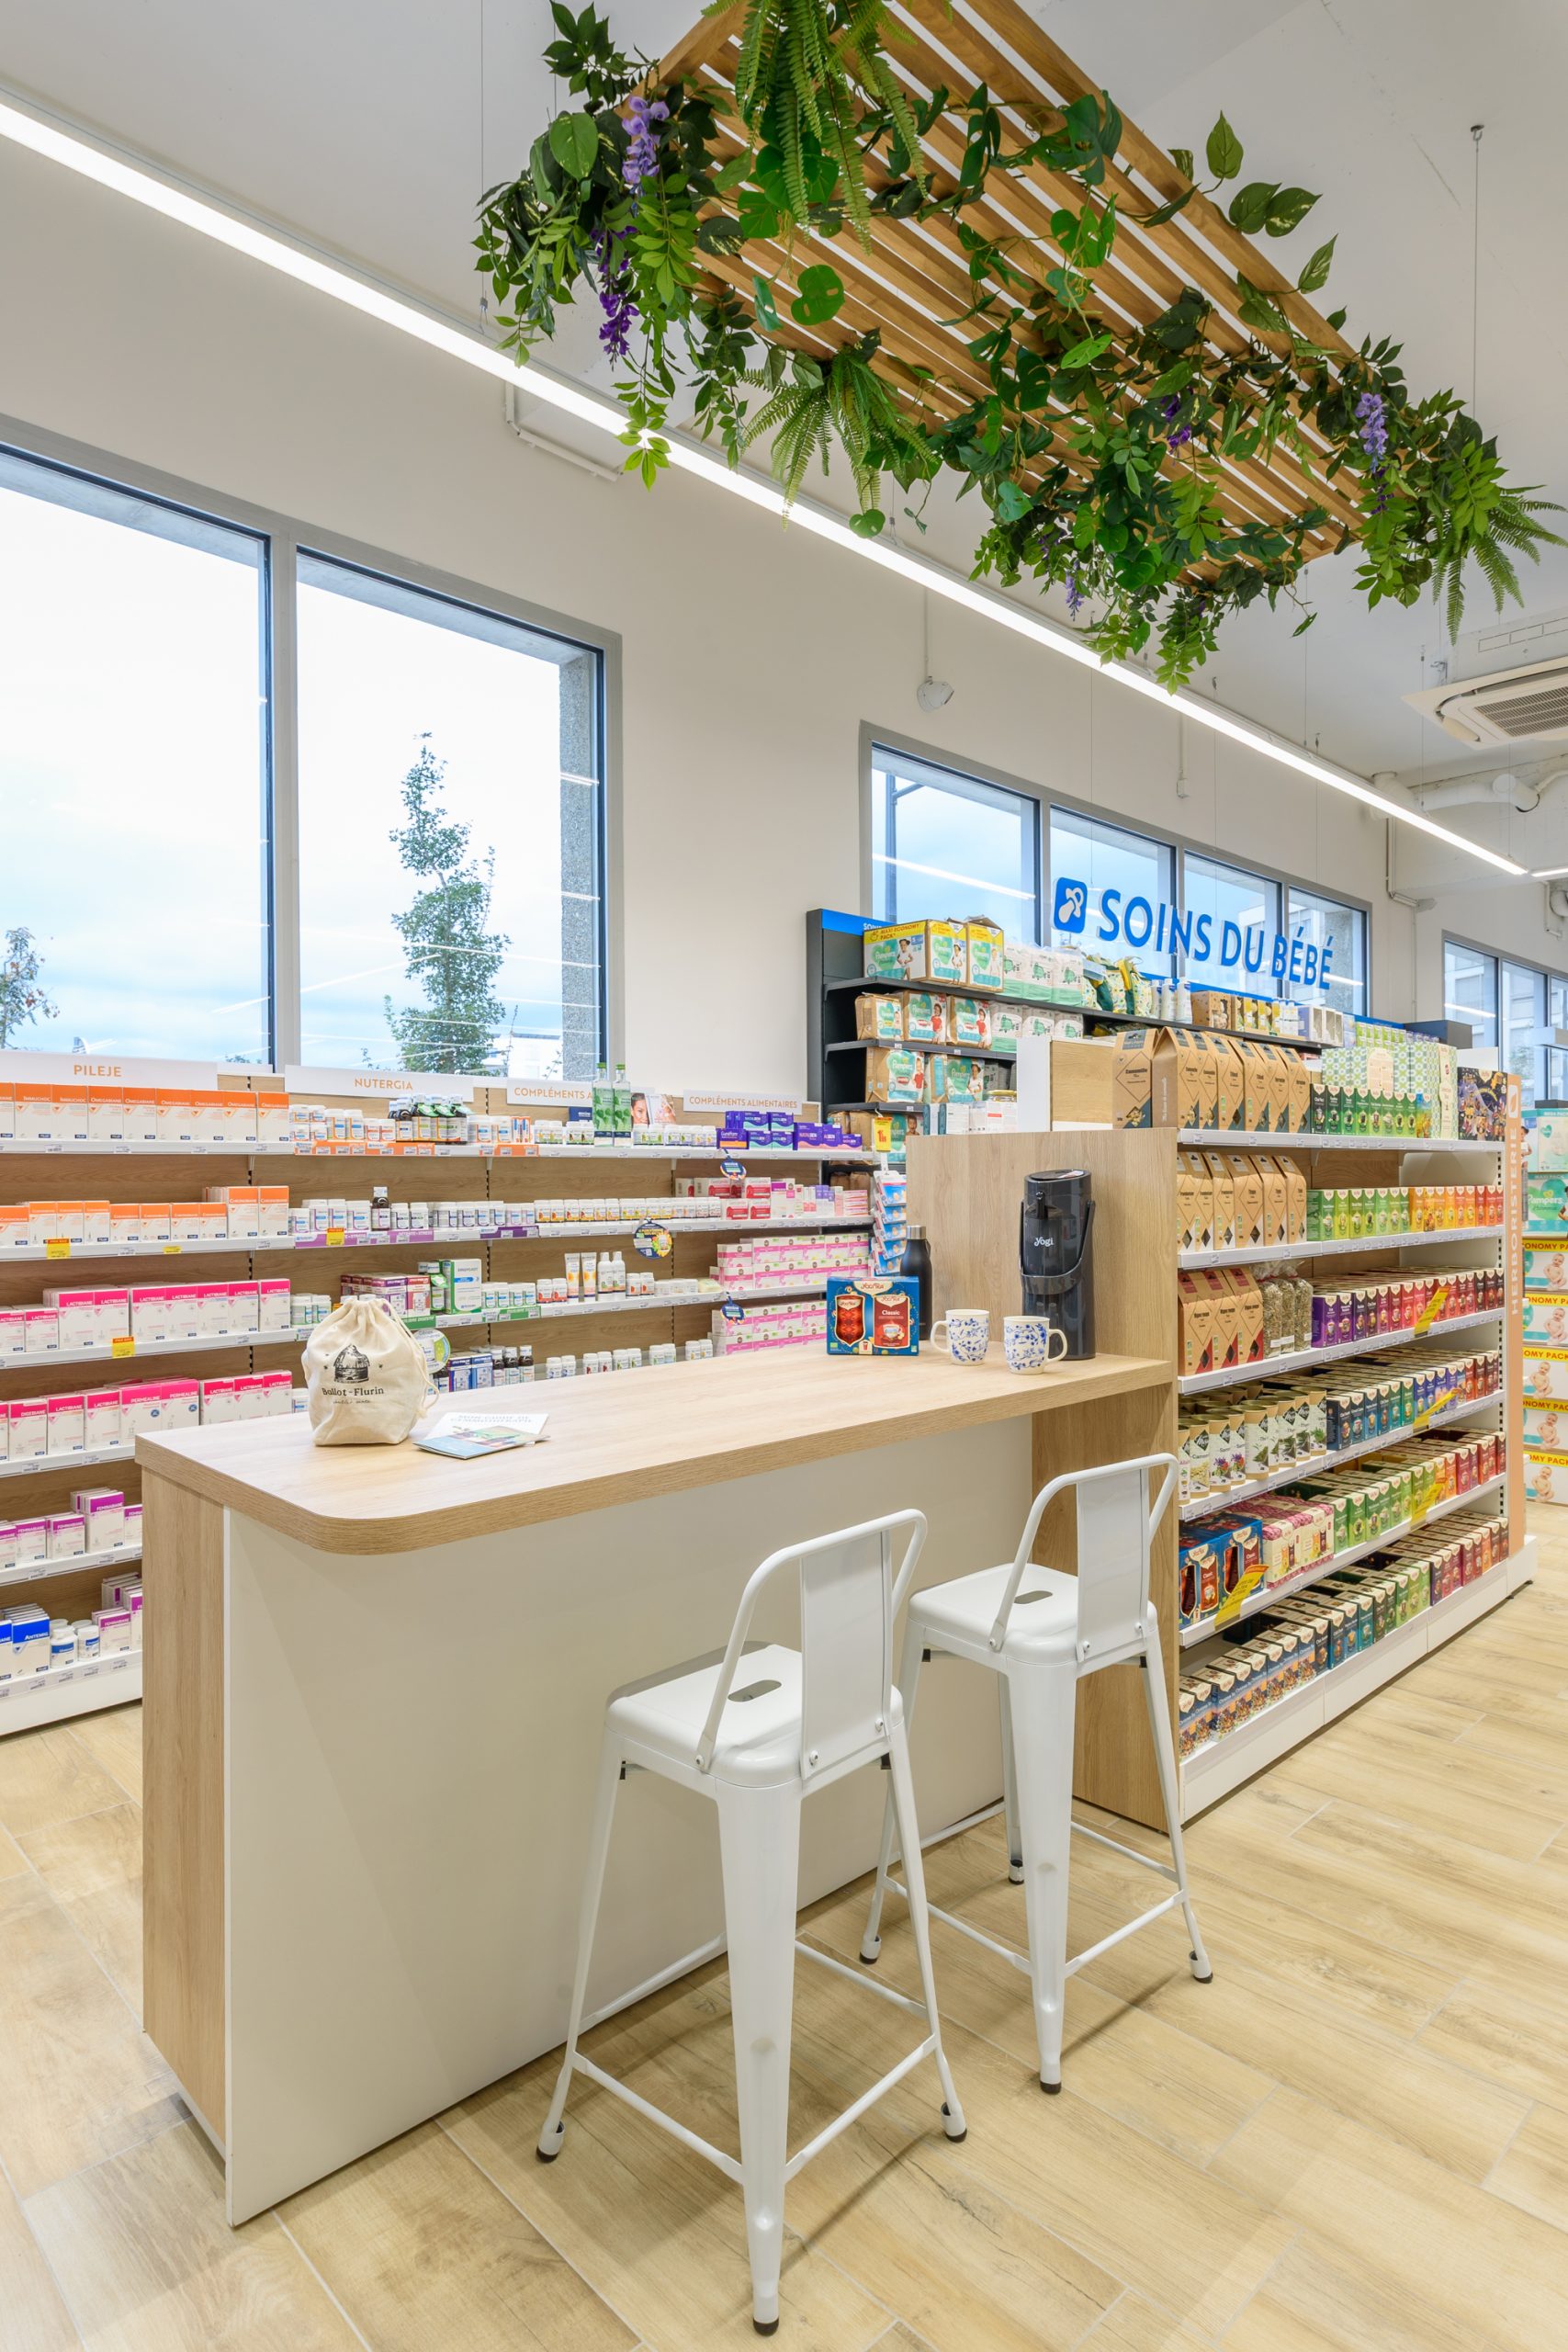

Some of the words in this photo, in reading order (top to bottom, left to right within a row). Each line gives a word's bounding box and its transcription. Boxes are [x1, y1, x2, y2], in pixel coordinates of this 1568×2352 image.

[1098, 888, 1213, 962] SOINS
[1220, 920, 1265, 973] DU
[1271, 926, 1334, 989] BÉBÉ
[73, 1064, 122, 1078] PILEJE
[354, 1078, 413, 1091] NUTERGIA
[513, 1086, 585, 1100] COMPLÉMENTS
[689, 1094, 746, 1106] COMPLÉMENTS
[748, 1100, 797, 1109] ALIMENTAIRES
[1529, 1194, 1562, 1205] Pampers
[1033, 1236, 1055, 1248] Yogi
[1525, 1242, 1558, 1250] ONOMY
[240, 1384, 263, 1392] LACTIBIANE
[268, 1380, 291, 1388] LACTIBIANE
[94, 1400, 118, 1408] LACTIBIANE
